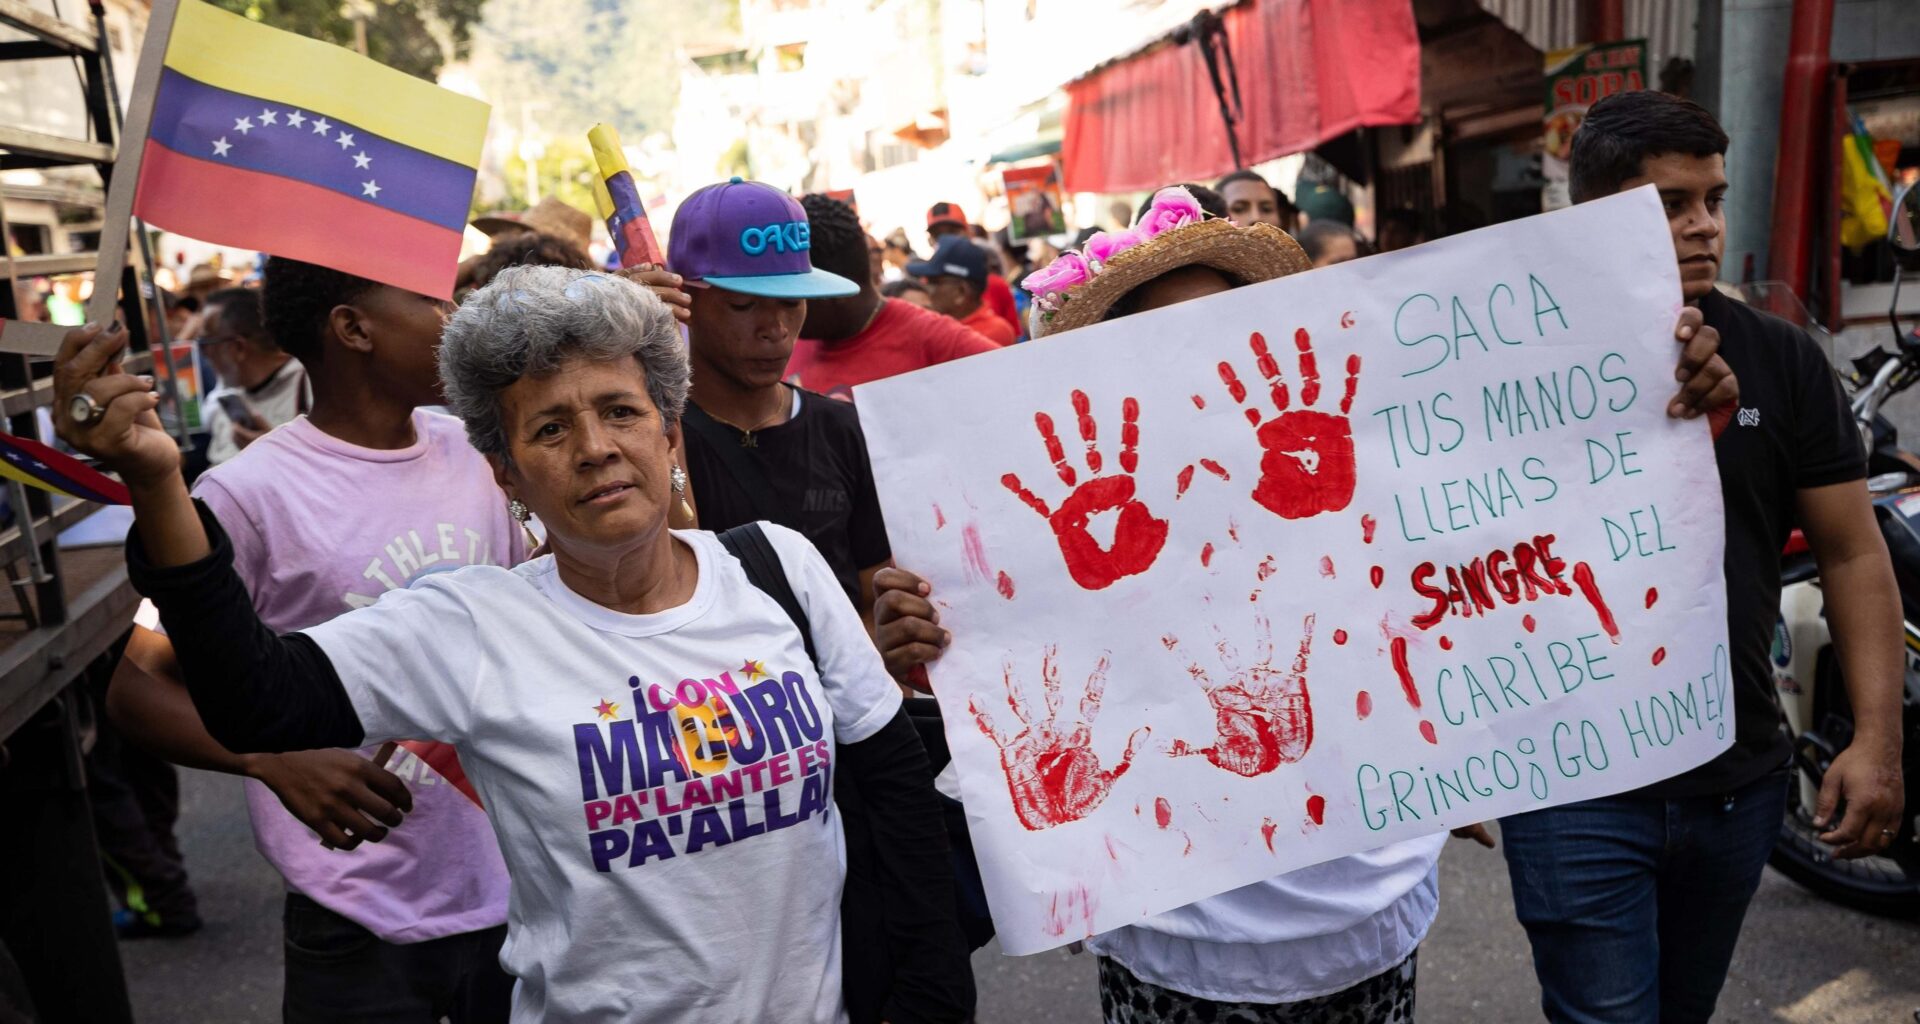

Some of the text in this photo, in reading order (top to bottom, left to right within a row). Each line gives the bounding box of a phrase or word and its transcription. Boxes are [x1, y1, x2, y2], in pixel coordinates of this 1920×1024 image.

[740, 222, 811, 256] OAKLE
[1394, 273, 1569, 377] SACA
[1372, 352, 1637, 469] TUS MANOS
[1395, 431, 1643, 541] LLENAS DE
[1602, 504, 1676, 561] DEL
[1411, 534, 1573, 630] SANGRE
[1619, 644, 1727, 759] HOME!
[584, 740, 831, 831] PA'LANTE ES
